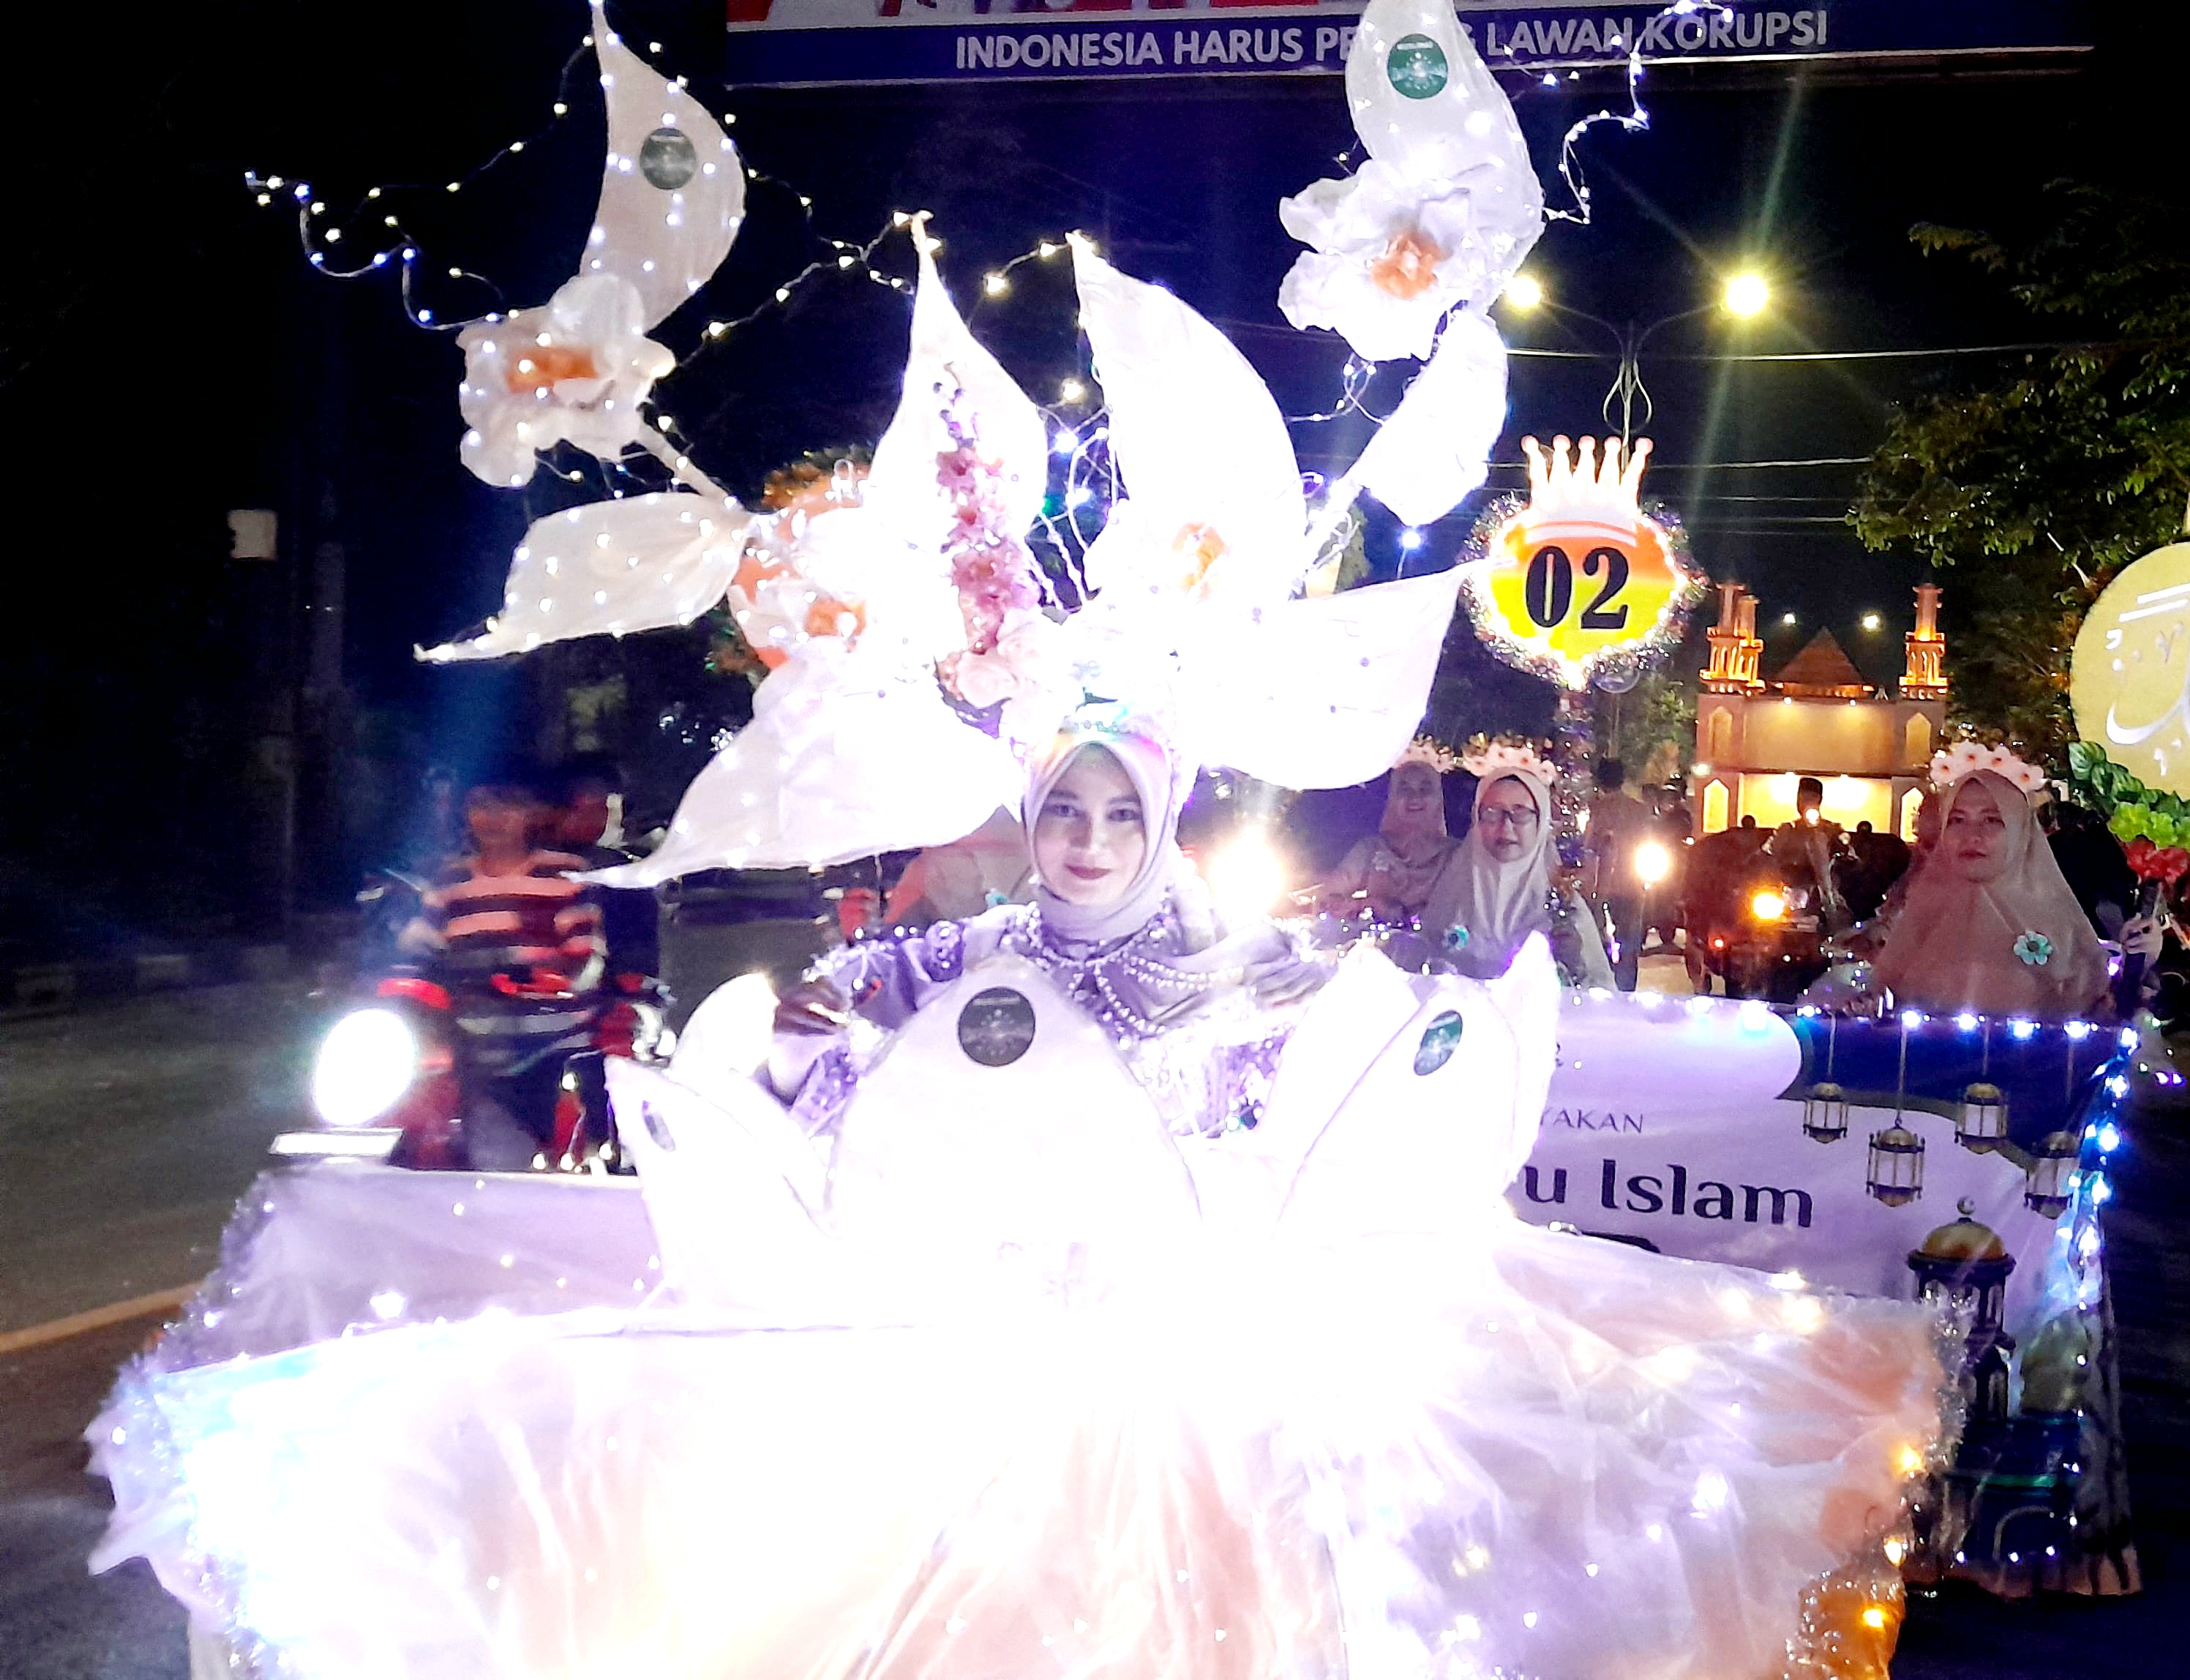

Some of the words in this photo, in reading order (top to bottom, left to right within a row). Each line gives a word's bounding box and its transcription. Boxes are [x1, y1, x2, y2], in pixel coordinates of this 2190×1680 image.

[956, 32, 1163, 69] INDONESIA
[1174, 28, 1304, 64] HARUS
[1487, 18, 1632, 56] LAWAN
[1646, 10, 1827, 50] KORUPSI
[1526, 546, 1629, 629] 02
[1540, 1106, 1643, 1133] YAKAN
[1601, 1159, 1813, 1228] Islam
